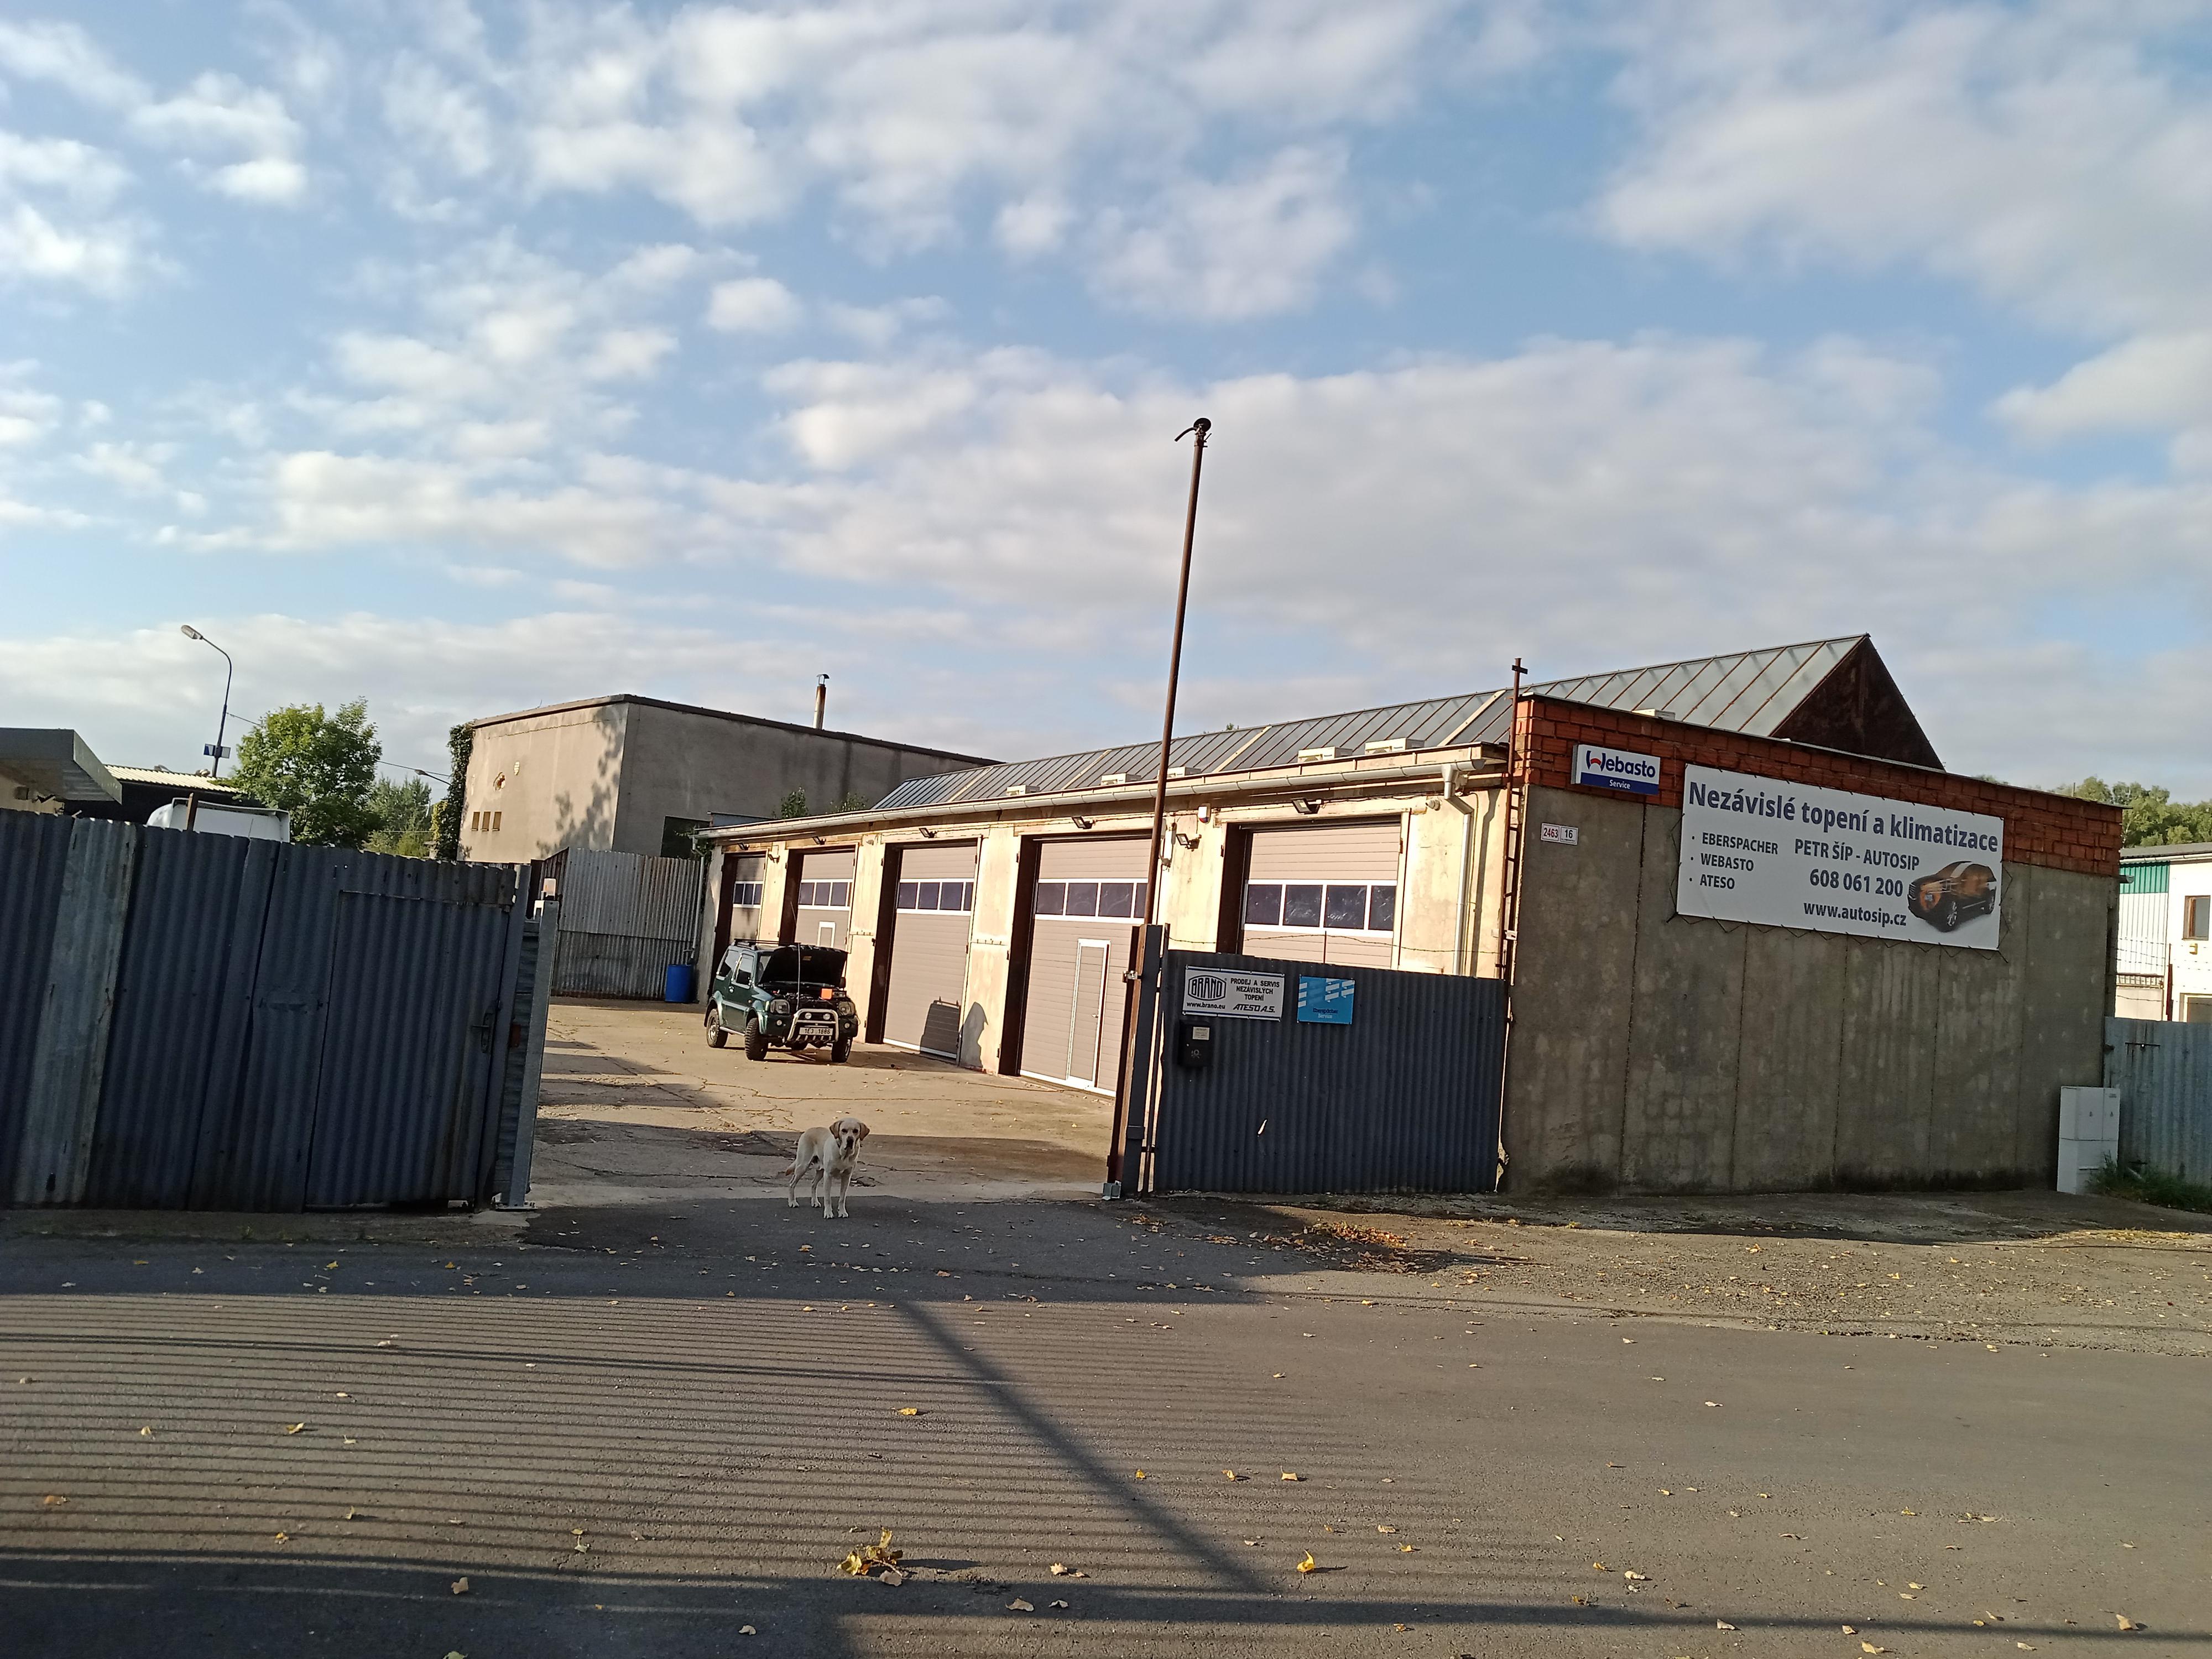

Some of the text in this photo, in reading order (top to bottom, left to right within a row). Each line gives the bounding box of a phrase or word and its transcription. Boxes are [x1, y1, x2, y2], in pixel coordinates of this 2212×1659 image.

[1586, 750, 1656, 778] Webasto
[1609, 779, 1631, 789] Service
[1689, 781, 1998, 852] Nezávislé topení a klimatizace
[1543, 827, 1573, 838] 2463 16
[1702, 832, 1778, 855] EBERSPACHER
[1700, 852, 1754, 872] WEBASTO
[1794, 838, 1829, 858] PETR
[1832, 841, 1853, 861] ŠÍP
[1863, 848, 1920, 870] AUTOSIP
[1699, 874, 1735, 890] ATESO
[1809, 868, 1903, 898] 608 061 200
[1803, 902, 1907, 927] www.autosip.cz
[1191, 977, 1223, 999] BRANO
[1236, 985, 1274, 994] NEZÁVISLÝCH
[1233, 1003, 1260, 1011] ATESO
